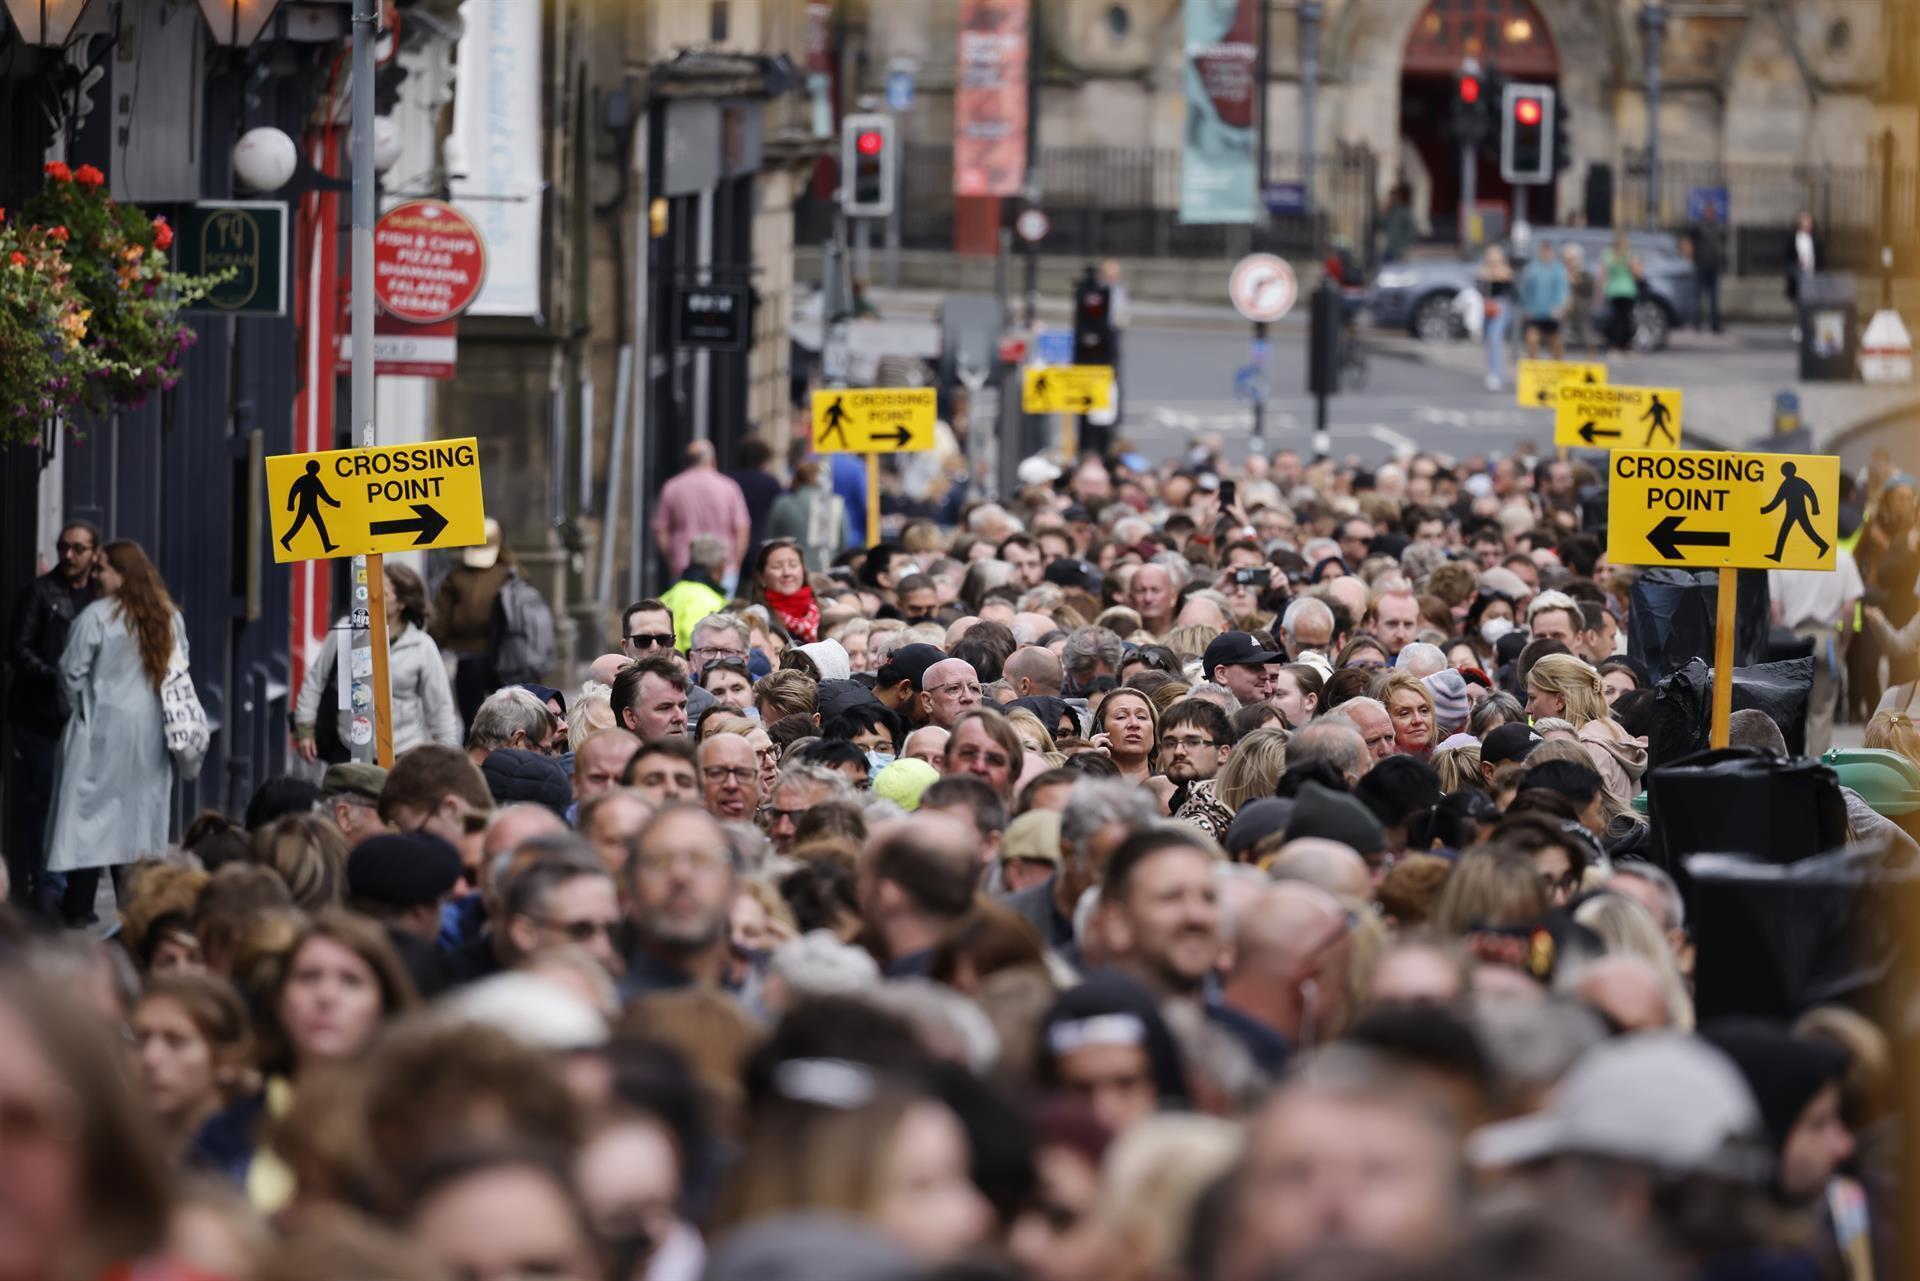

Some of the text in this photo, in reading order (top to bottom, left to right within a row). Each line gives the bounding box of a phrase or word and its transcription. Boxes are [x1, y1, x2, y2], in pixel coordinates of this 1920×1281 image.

[377, 230, 476, 255] FISH & CHIPS
[397, 249, 453, 267] PIZZAS
[378, 262, 469, 285] SHAWARMA
[387, 278, 454, 298] FALAFEL
[390, 295, 450, 313] KEBABS
[850, 393, 933, 409] CROSSING
[1560, 386, 1643, 404] CROSSING
[868, 409, 914, 424] POINT
[1577, 404, 1622, 420] POINT
[335, 445, 475, 478] CROSSING
[1615, 456, 1764, 482] CROSSING
[367, 477, 445, 503] POINT
[1647, 488, 1730, 511] POINT
